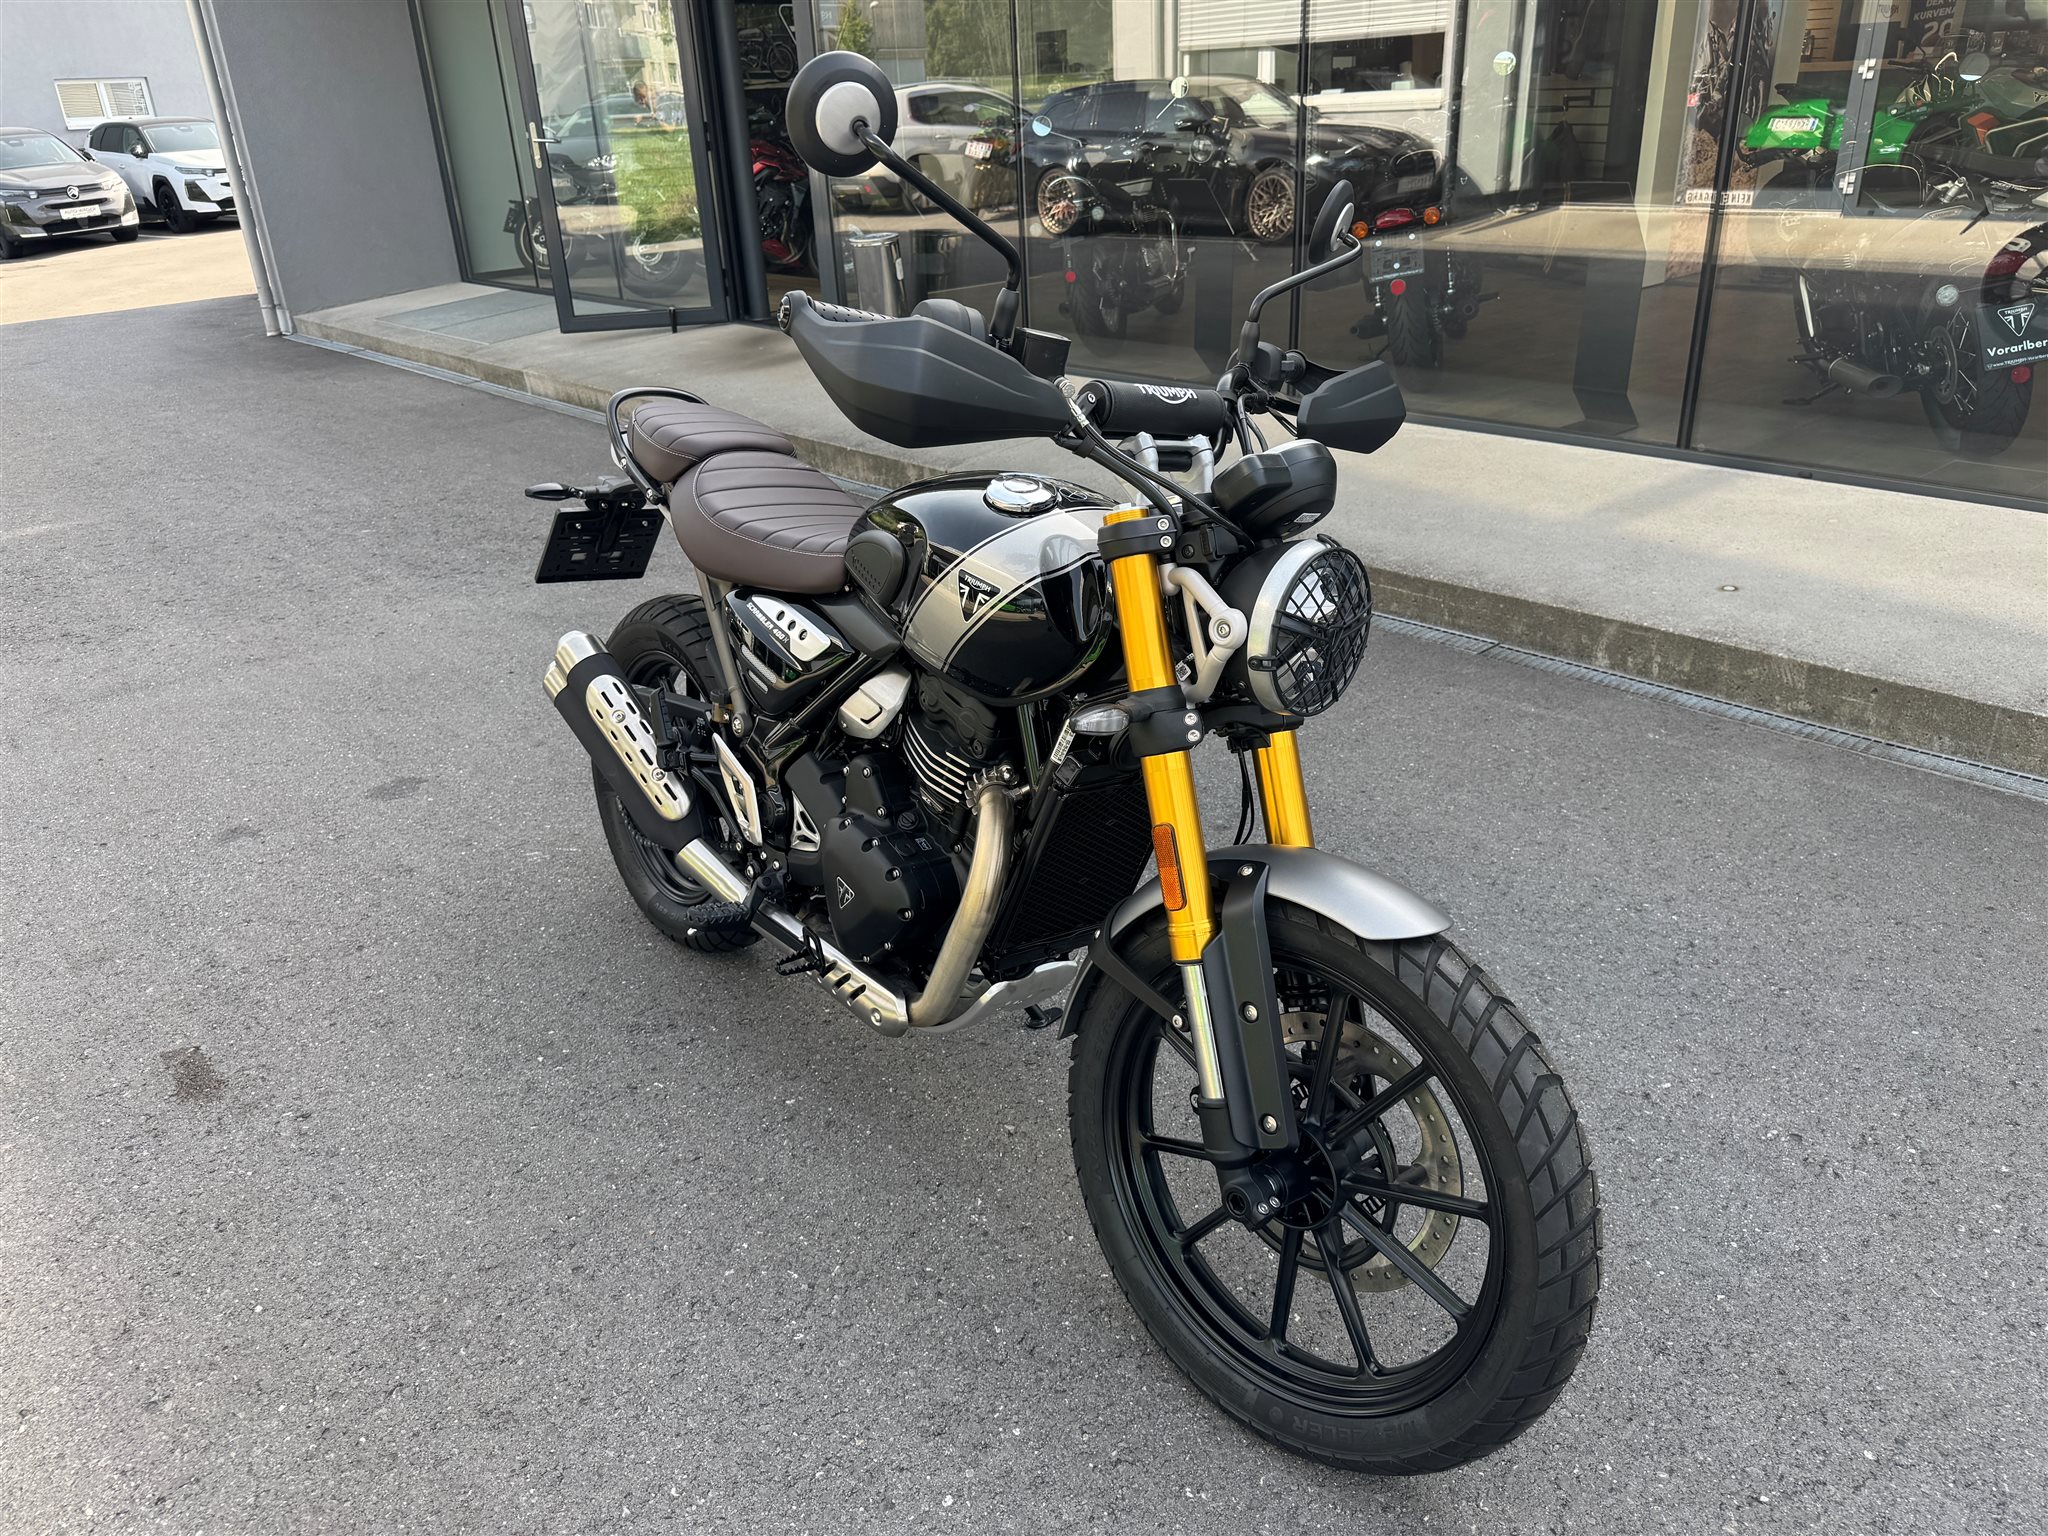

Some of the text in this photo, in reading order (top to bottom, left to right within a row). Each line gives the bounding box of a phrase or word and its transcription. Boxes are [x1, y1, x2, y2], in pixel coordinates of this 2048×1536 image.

[2004, 306, 2028, 315] TRIUMPH
[1134, 383, 1198, 404] TRIUMPH
[964, 574, 992, 593] TRIUMPH
[746, 602, 774, 631] SCRAMBLER
[772, 628, 786, 640] 400
